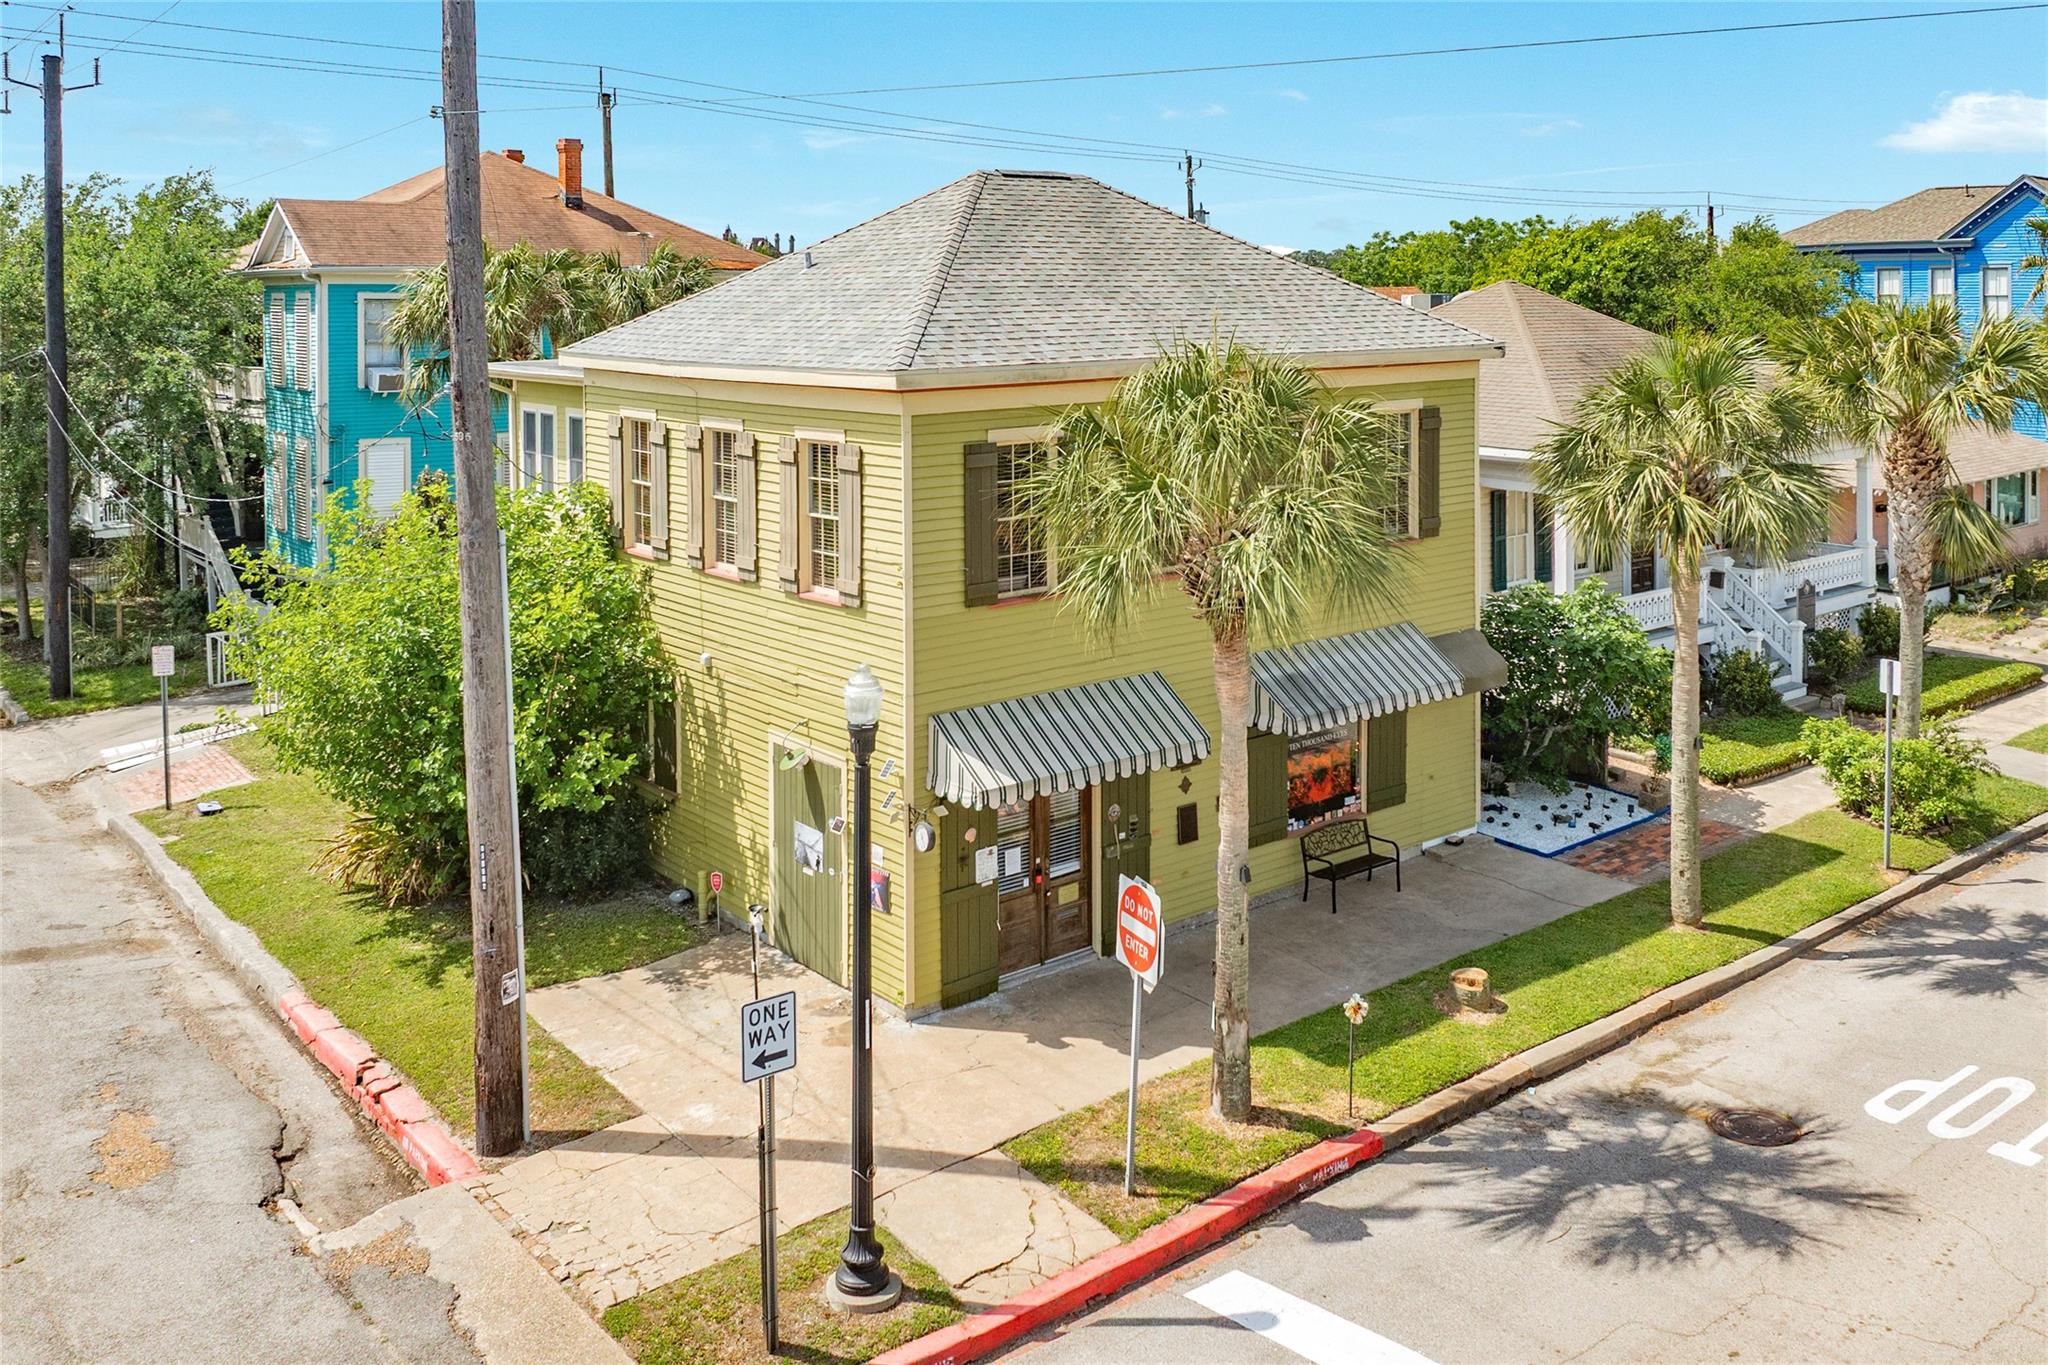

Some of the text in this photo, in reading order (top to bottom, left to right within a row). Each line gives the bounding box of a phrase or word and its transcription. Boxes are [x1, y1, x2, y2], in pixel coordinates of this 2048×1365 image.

[1289, 742, 1300, 751] TEN
[1124, 895, 1154, 925] DO NOT
[1125, 934, 1149, 961] ENTER
[749, 999, 789, 1027] ONE
[748, 1020, 790, 1049] WAY
